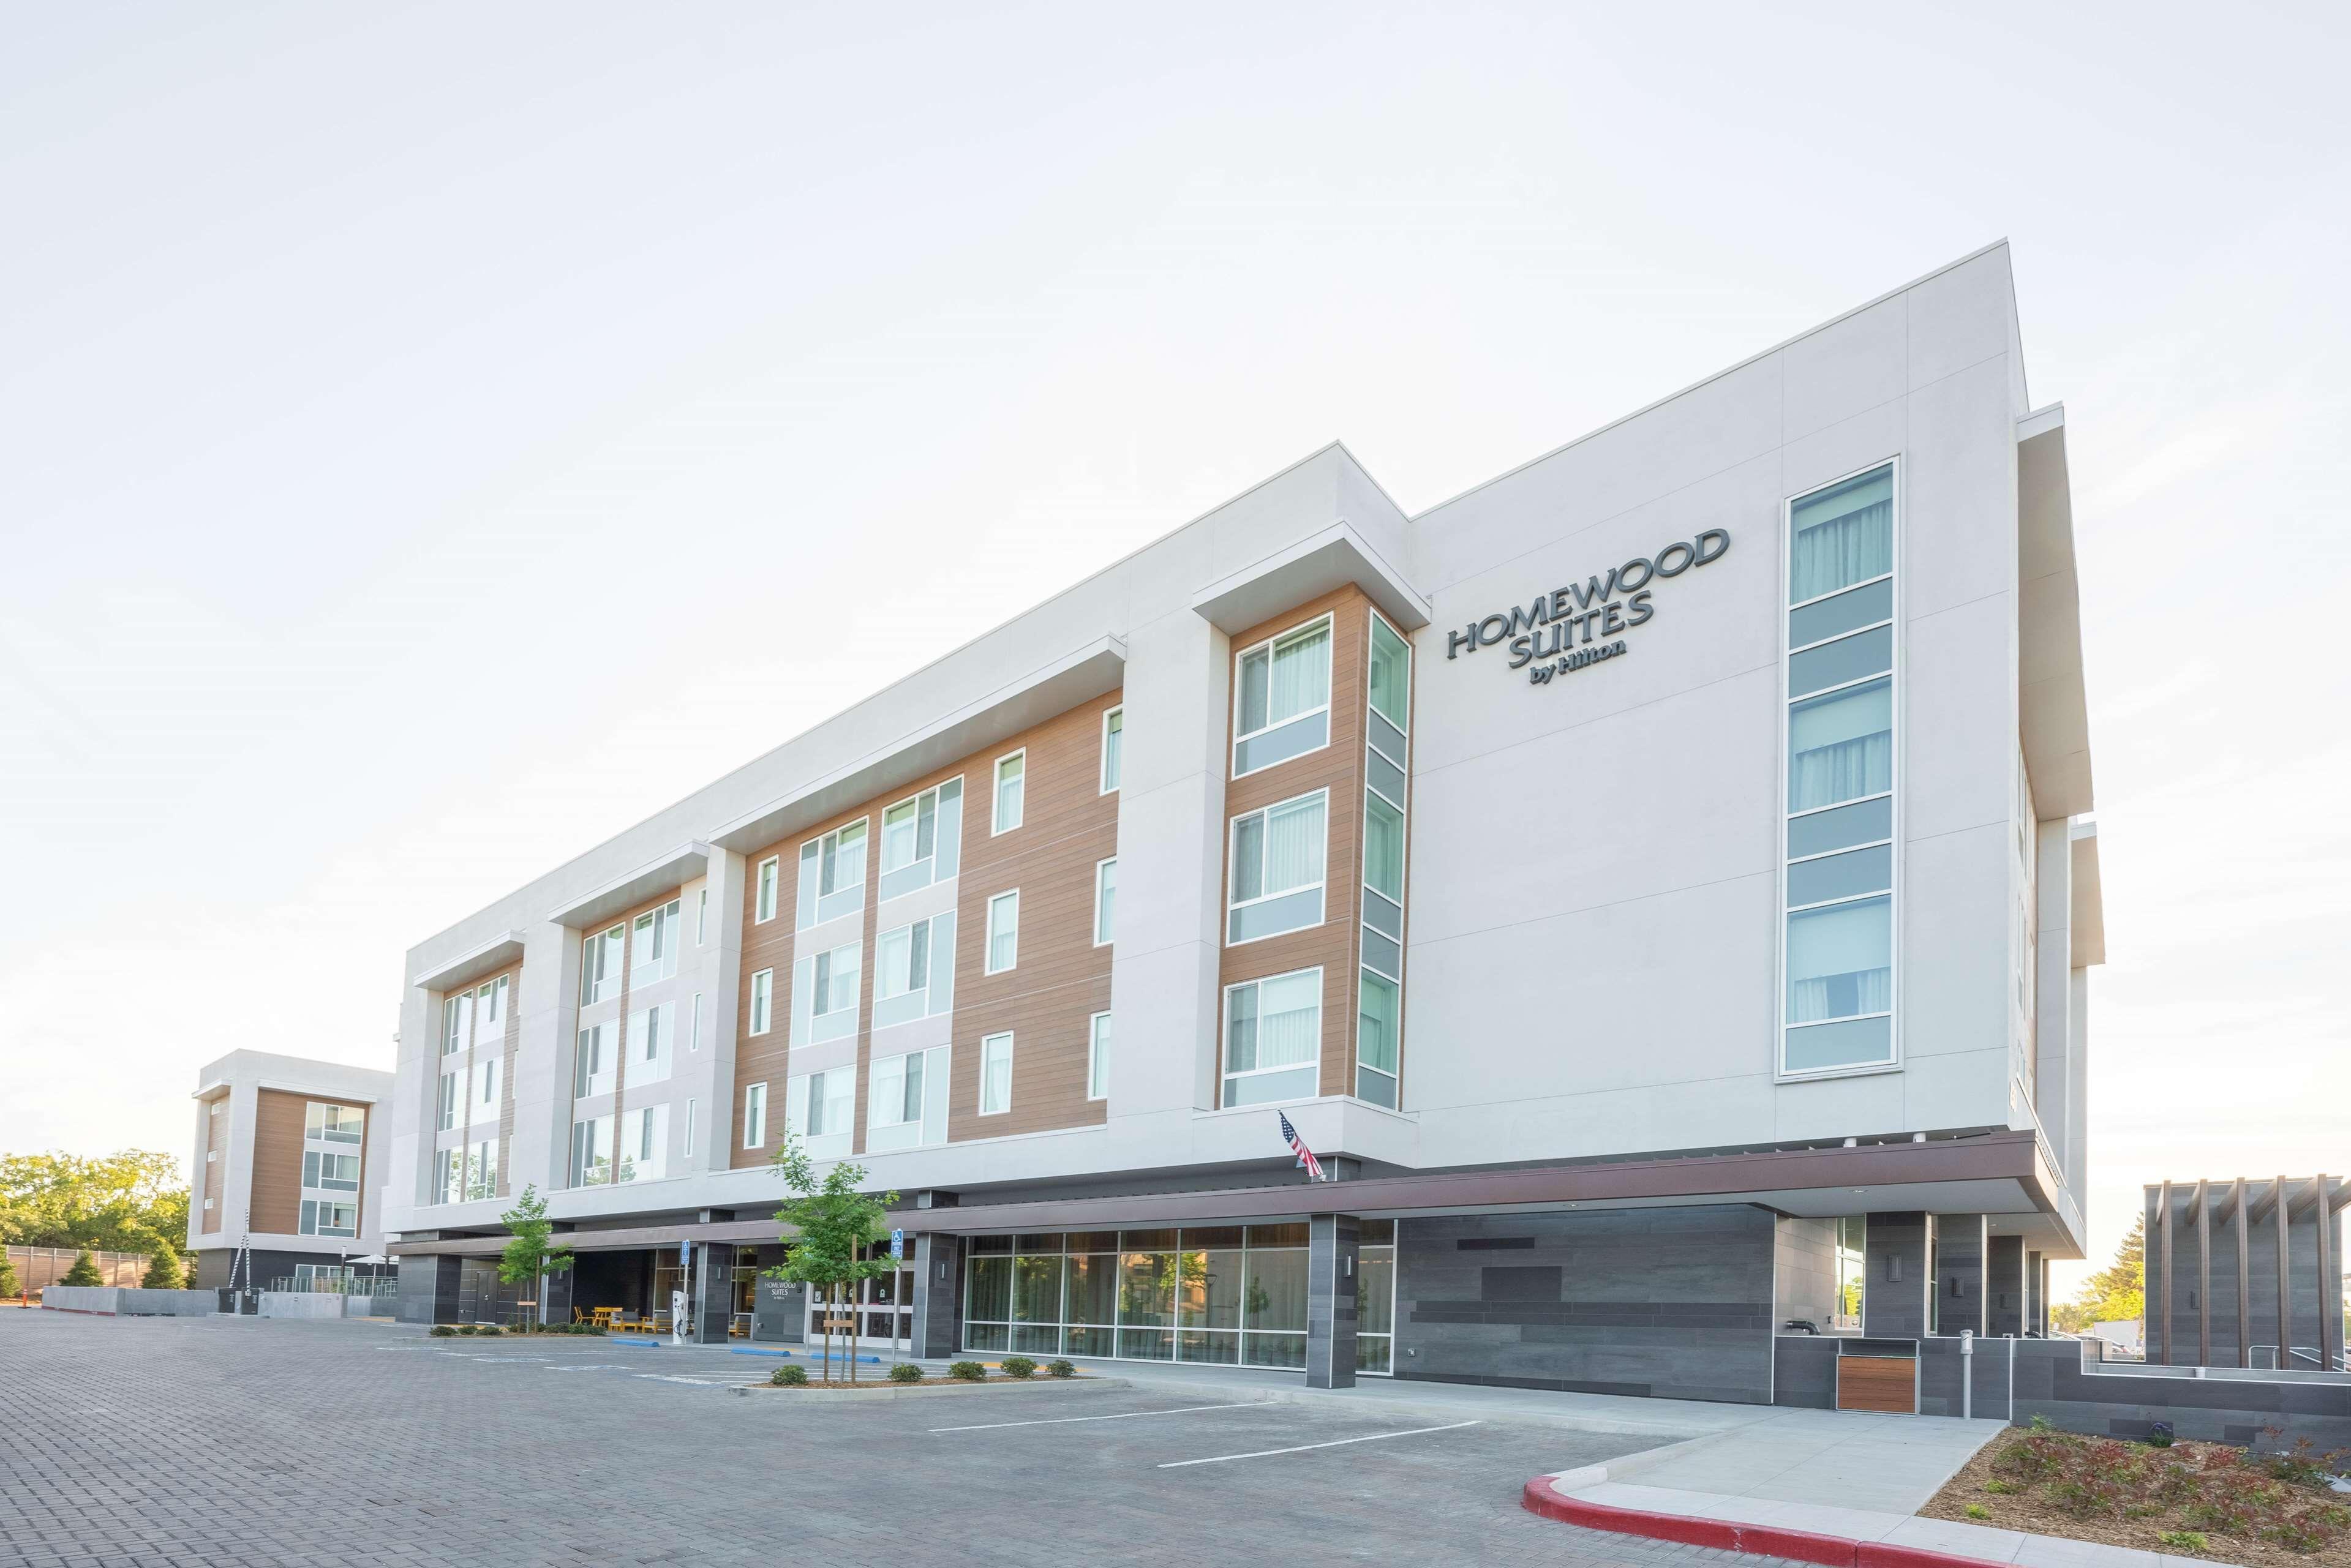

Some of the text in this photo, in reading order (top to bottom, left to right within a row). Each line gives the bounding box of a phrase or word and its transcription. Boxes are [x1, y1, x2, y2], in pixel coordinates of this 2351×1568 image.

[1447, 528, 1730, 659] HOMEWOOD
[1509, 590, 1654, 669] SUITES
[1530, 640, 1627, 685] by Hilton
